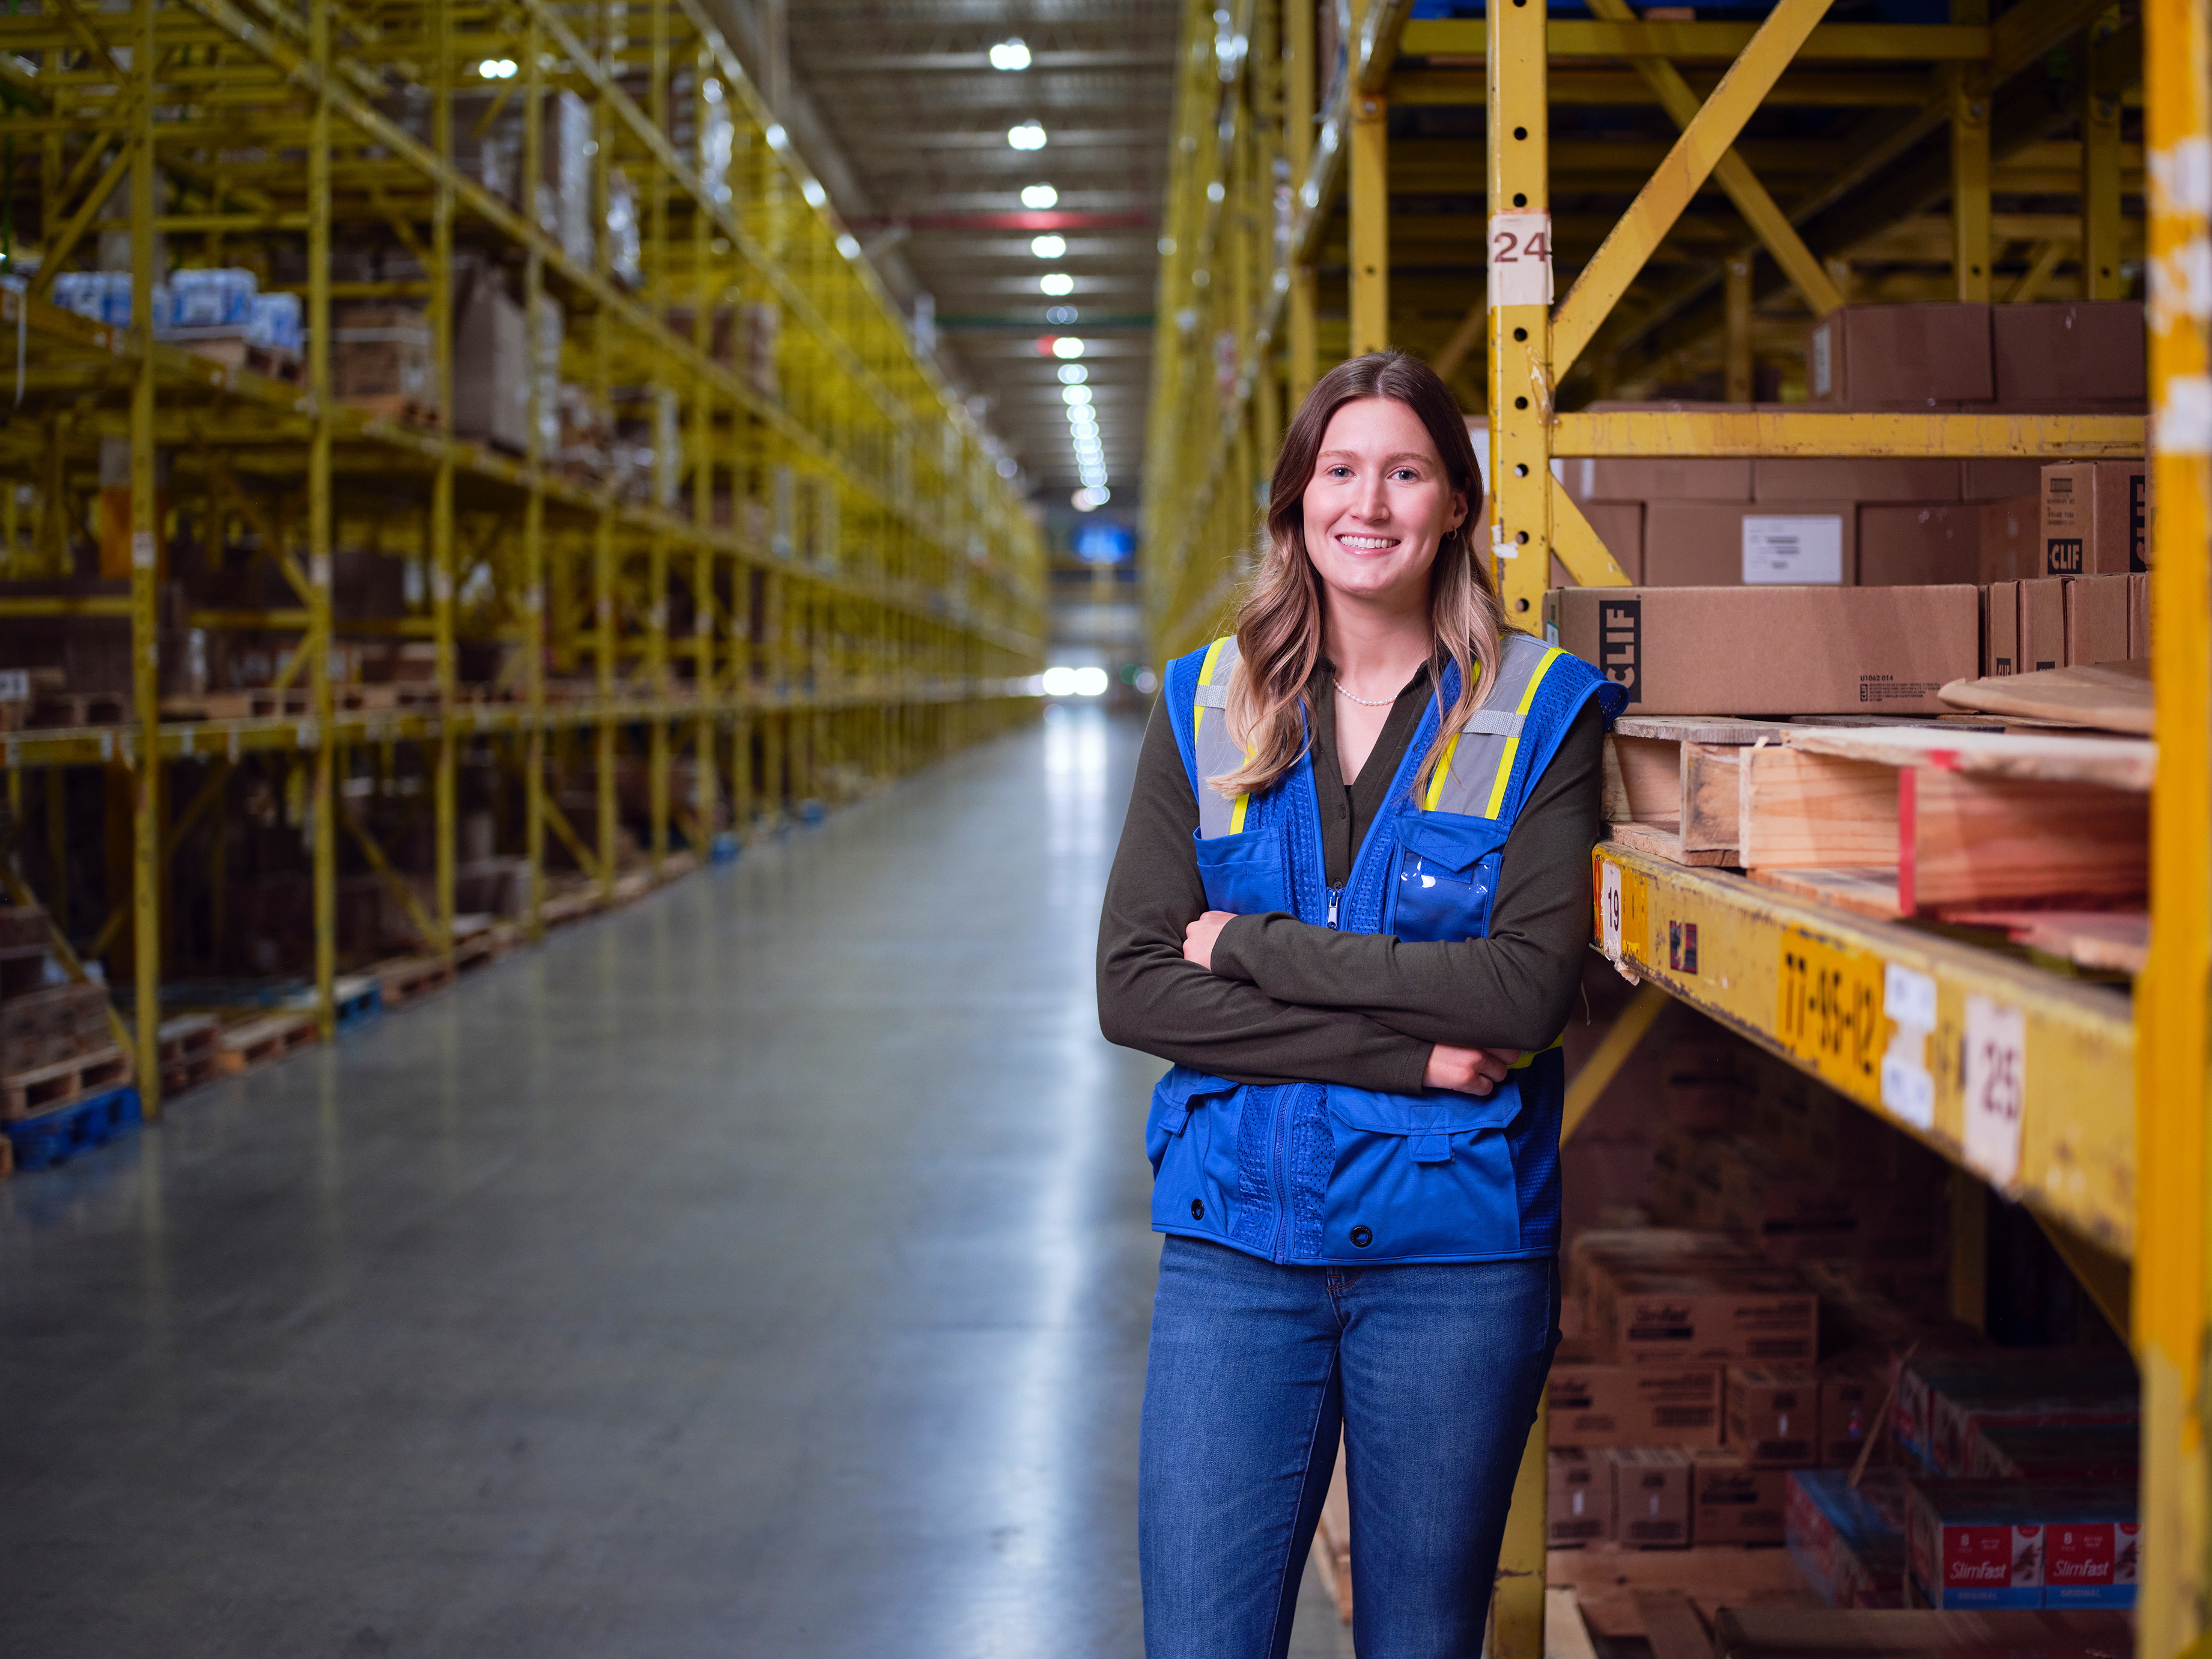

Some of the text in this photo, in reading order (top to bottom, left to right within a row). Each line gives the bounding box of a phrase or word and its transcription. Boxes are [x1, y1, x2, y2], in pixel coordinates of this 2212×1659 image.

[1494, 232, 1546, 262] 24
[2052, 544, 2080, 570] CLIF
[1606, 608, 1635, 690] CLIF
[1608, 887, 1619, 932] 19
[1982, 1042, 2020, 1121] 25
[2064, 1532, 2073, 1545] 8
[1949, 1561, 2007, 1580] SlimFast
[2053, 1559, 2109, 1577] SlimFast
